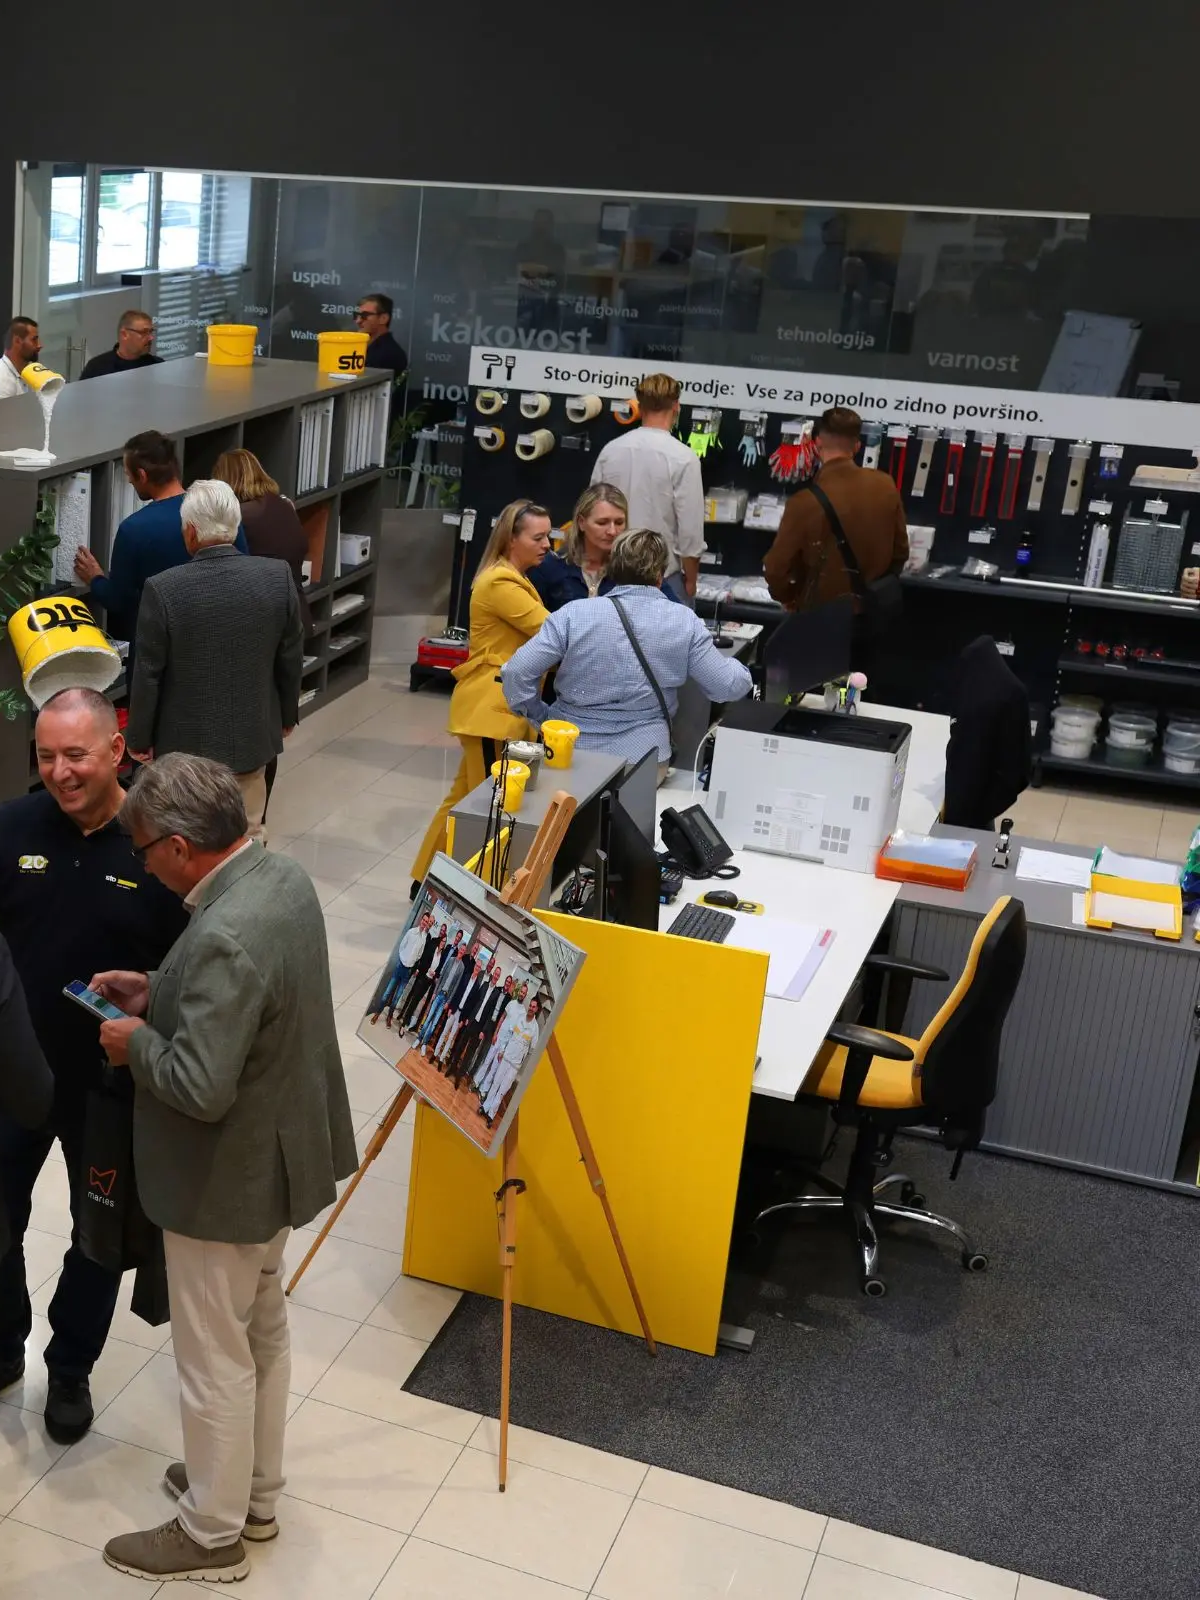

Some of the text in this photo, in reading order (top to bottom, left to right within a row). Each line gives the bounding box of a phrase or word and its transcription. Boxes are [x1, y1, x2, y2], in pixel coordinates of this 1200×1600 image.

[292, 269, 342, 288] uspeh
[290, 330, 319, 341] Walte
[431, 313, 592, 353] kakovost
[776, 325, 875, 350] tehnologija
[338, 350, 366, 370] sto
[927, 349, 1020, 374] varnost
[422, 377, 469, 402] inov
[544, 366, 646, 389] Sto-Original
[746, 383, 778, 400] Vse
[783, 388, 804, 402] za
[810, 389, 888, 411] popolno
[894, 396, 947, 415] zidno
[953, 402, 1044, 424] površino.
[26, 603, 98, 633] sto
